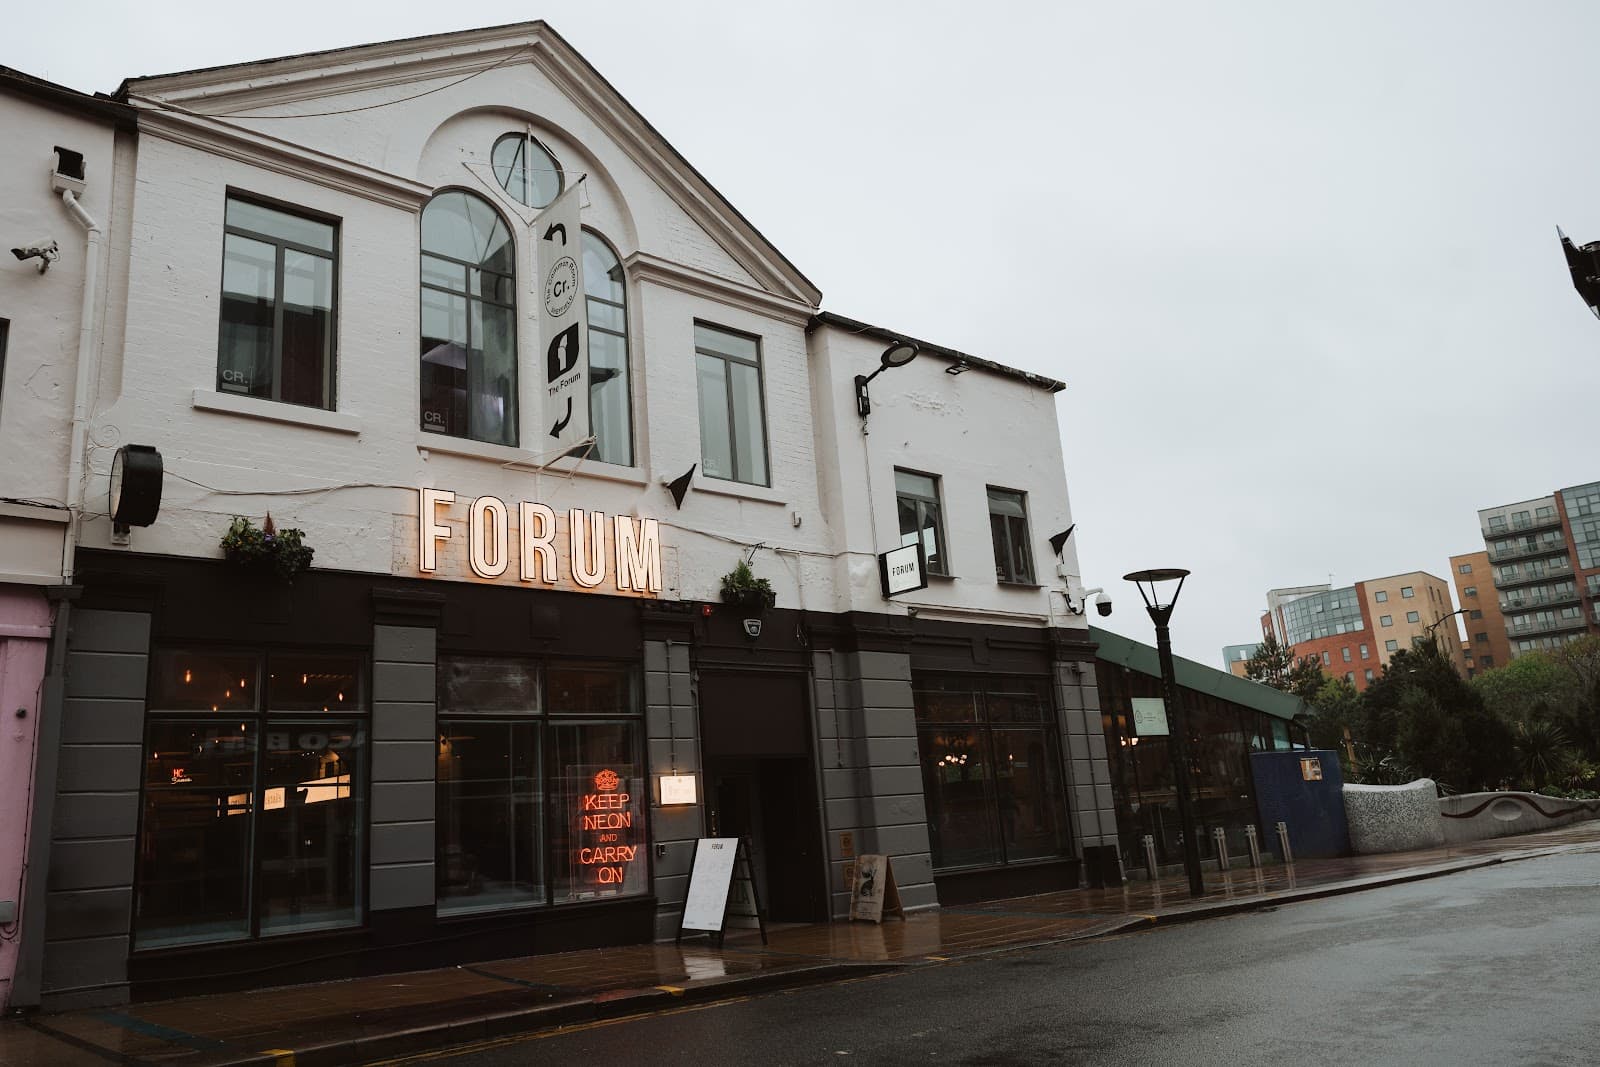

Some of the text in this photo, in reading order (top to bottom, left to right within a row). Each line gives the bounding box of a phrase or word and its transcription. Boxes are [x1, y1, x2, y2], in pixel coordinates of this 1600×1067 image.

[548, 261, 569, 285] Common
[568, 262, 576, 287] Room
[553, 280, 570, 297] Cr.
[223, 369, 248, 384] CR.
[548, 372, 581, 397] The Forum
[424, 410, 445, 424] CR.
[419, 487, 663, 593] FORUM
[892, 562, 915, 577] FORUM
[585, 793, 630, 811] KEEP
[584, 811, 631, 830] NEON
[600, 833, 618, 842] AND
[580, 845, 637, 864] CARRY
[599, 866, 623, 883] ON
